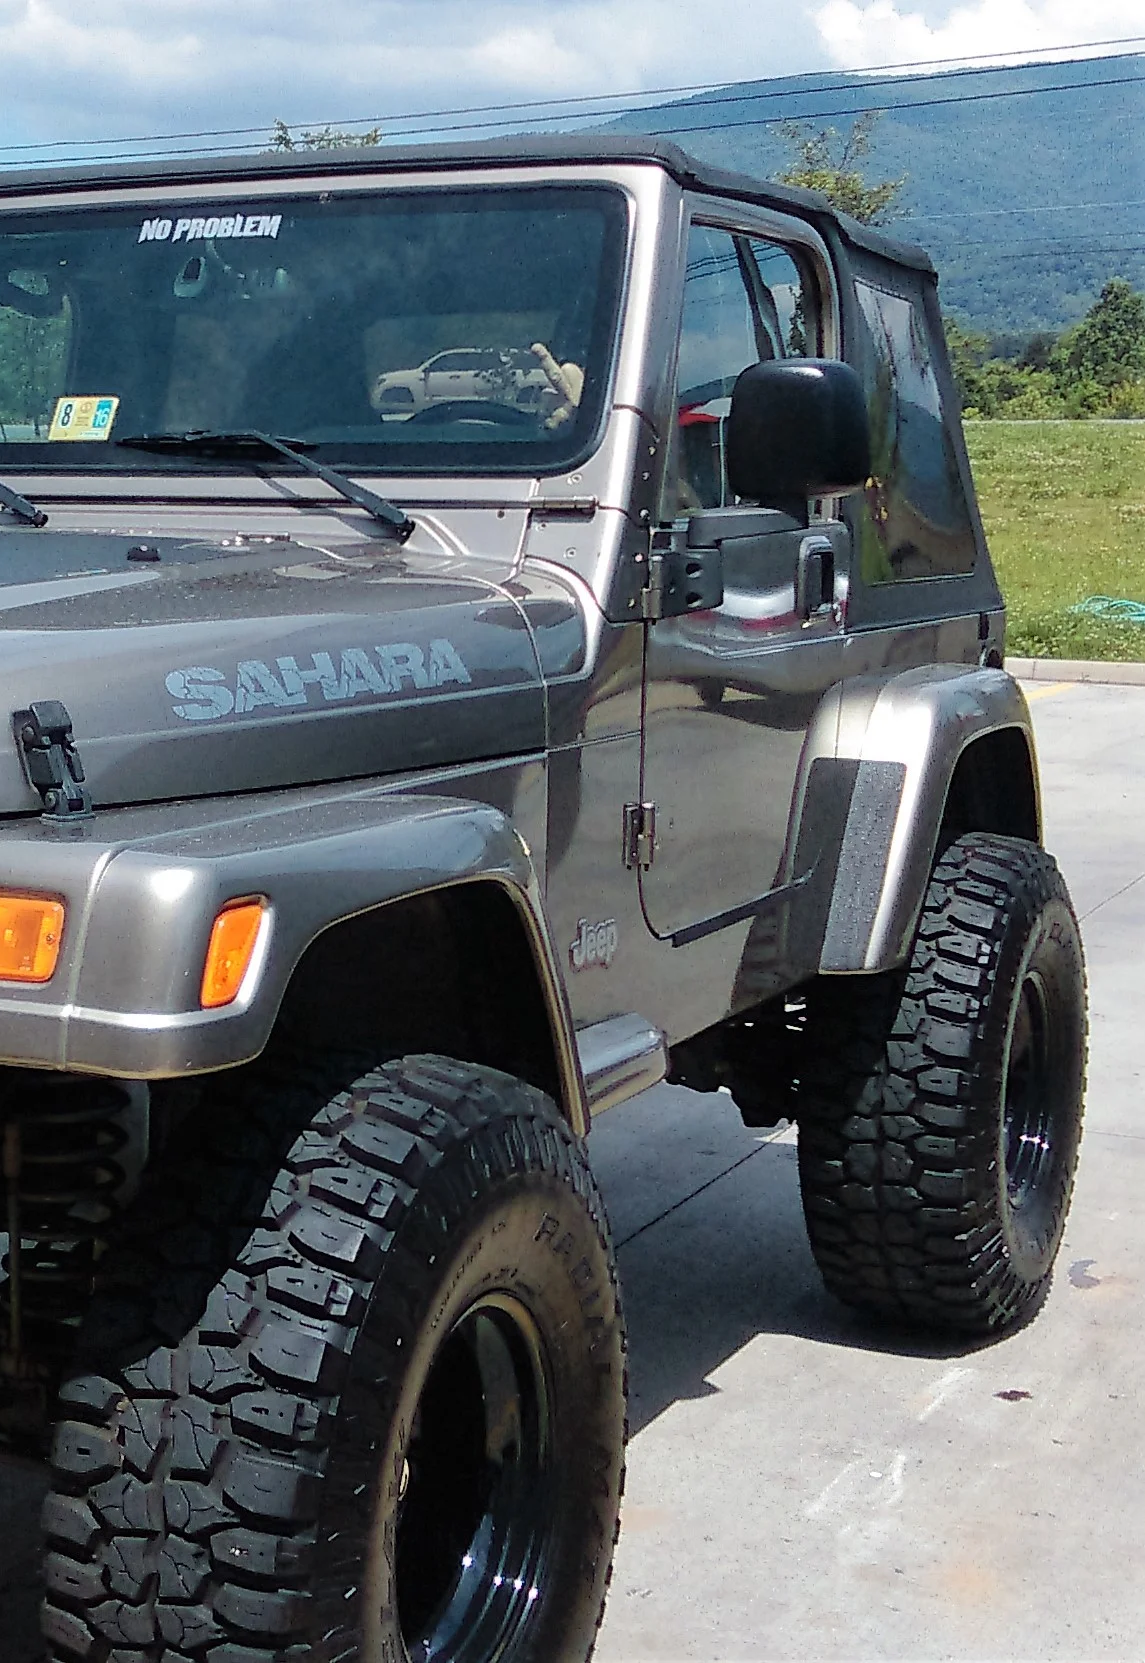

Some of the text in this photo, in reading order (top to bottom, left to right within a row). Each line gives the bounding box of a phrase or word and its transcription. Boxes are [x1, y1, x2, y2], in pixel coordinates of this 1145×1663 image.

[137, 213, 283, 244] NO PROBLEM
[61, 403, 73, 427] 8
[165, 638, 472, 720] SAHARA
[569, 917, 618, 970] Jeep
